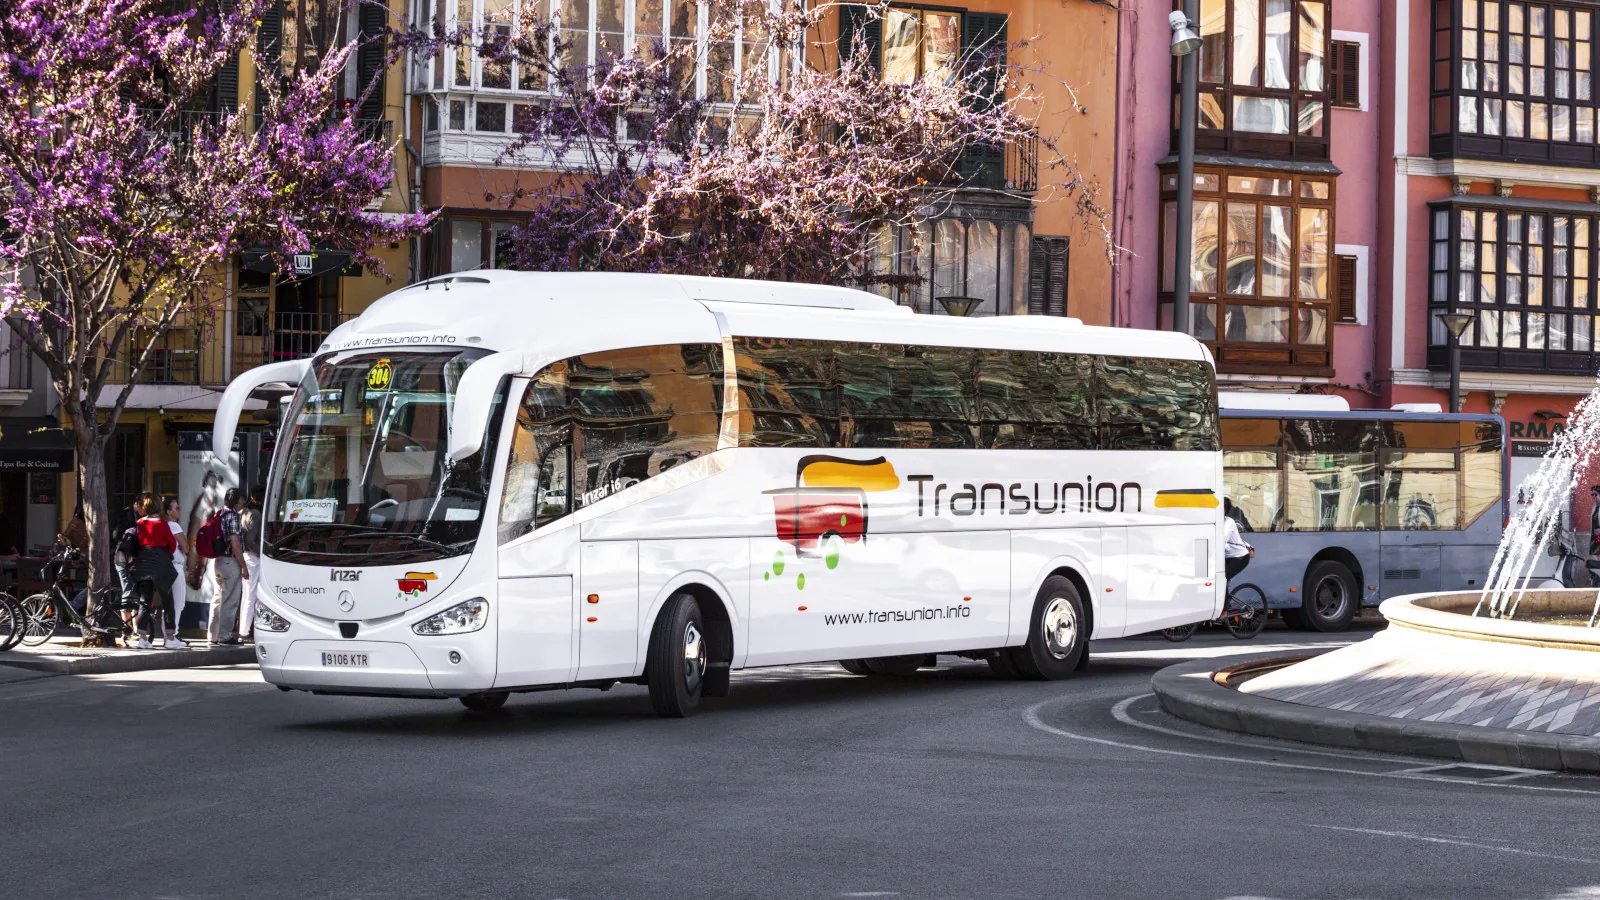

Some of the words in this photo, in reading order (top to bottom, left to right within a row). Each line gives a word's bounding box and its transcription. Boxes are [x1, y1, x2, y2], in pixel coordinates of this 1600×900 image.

[334, 334, 457, 350] www.transunion.info
[369, 367, 389, 385] 304
[1509, 421, 1567, 438] RMA
[0, 460, 15, 469] Tapas
[16, 460, 26, 468] Bar
[27, 460, 34, 468] &
[34, 460, 60, 468] Cocktails
[610, 477, 621, 494] i6
[907, 475, 1141, 516] Transunion
[275, 584, 325, 595] Transunion
[824, 604, 971, 626] www.transunion.info
[326, 653, 349, 666] 9106
[350, 653, 368, 666] KTR
